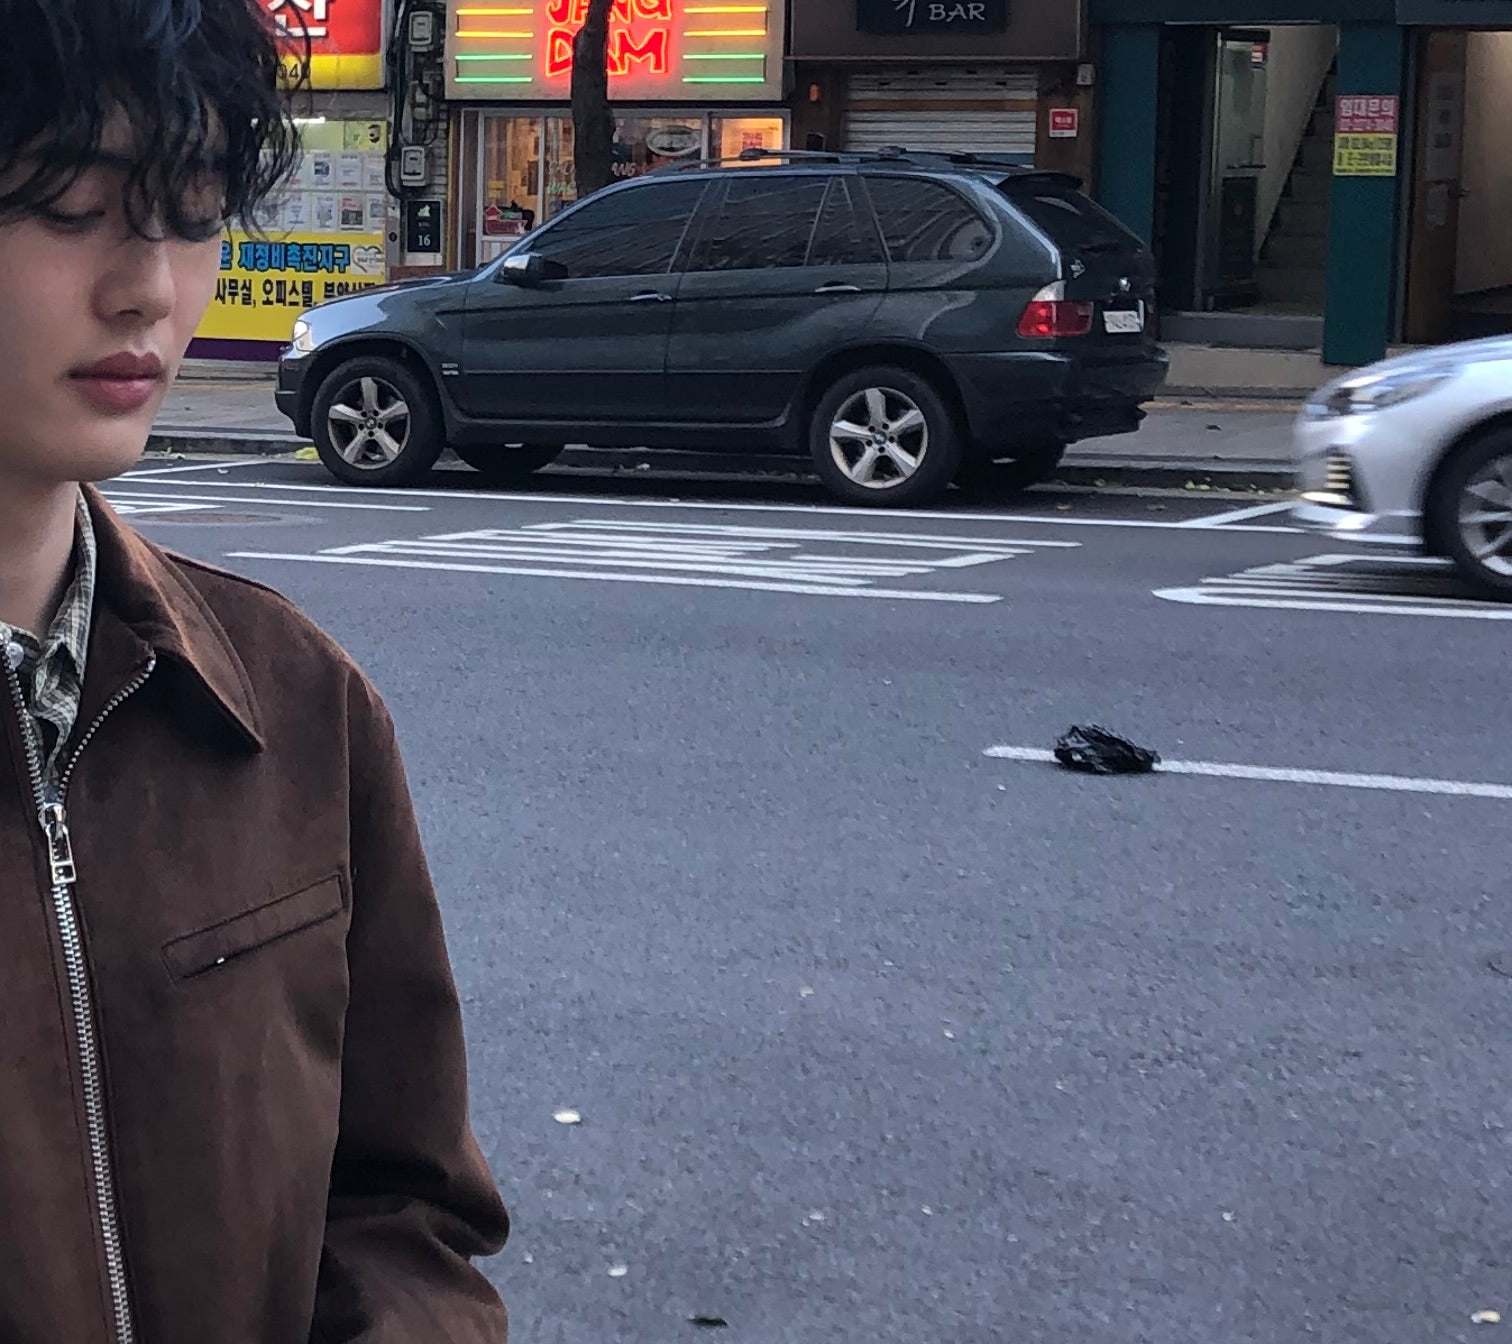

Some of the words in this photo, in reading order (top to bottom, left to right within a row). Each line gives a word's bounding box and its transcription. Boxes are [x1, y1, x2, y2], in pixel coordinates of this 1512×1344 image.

[929, 3, 985, 22] BAR
[546, 28, 667, 77] DM
[417, 234, 431, 247] 16
[238, 241, 351, 273] 재정비촉진지구
